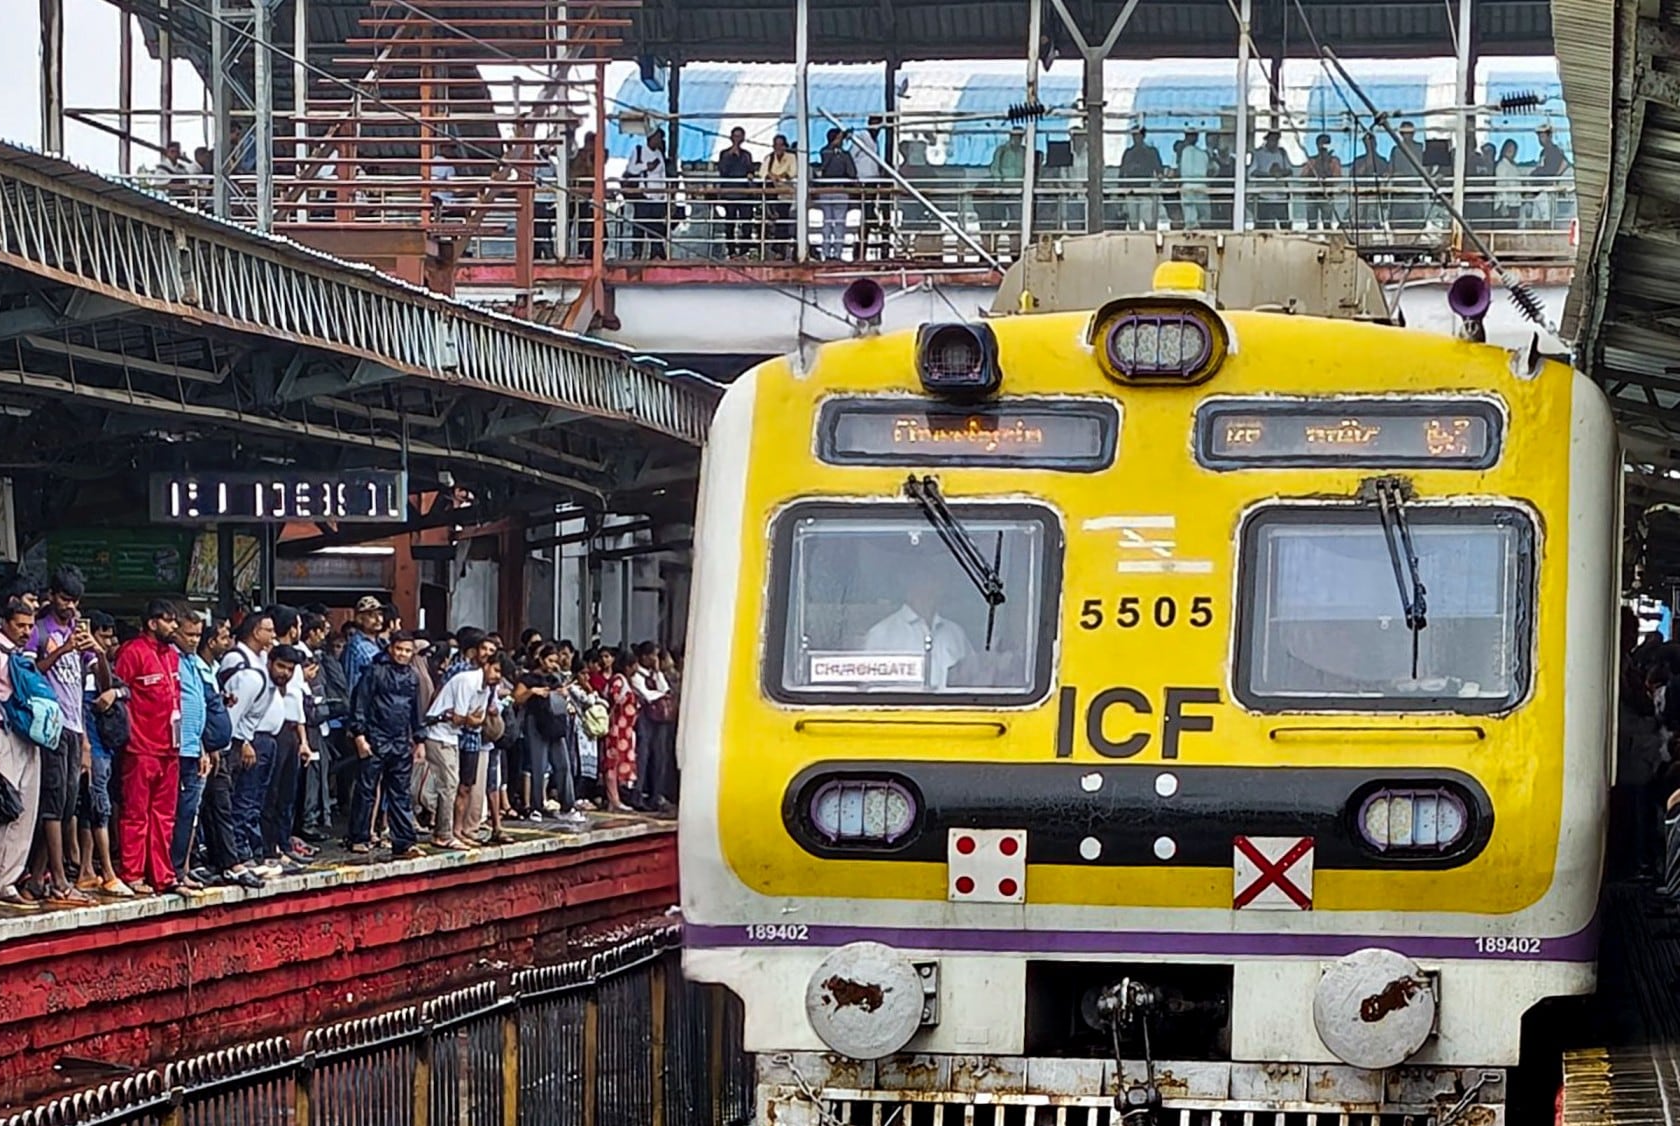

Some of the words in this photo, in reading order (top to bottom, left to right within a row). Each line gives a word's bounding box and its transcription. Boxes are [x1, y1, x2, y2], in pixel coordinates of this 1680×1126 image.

[1079, 596, 1213, 630] 5505
[814, 662, 918, 677] CHURCHGATE
[1055, 685, 1224, 760] ICF
[746, 923, 809, 940] 189402
[1475, 937, 1541, 953] 189402
